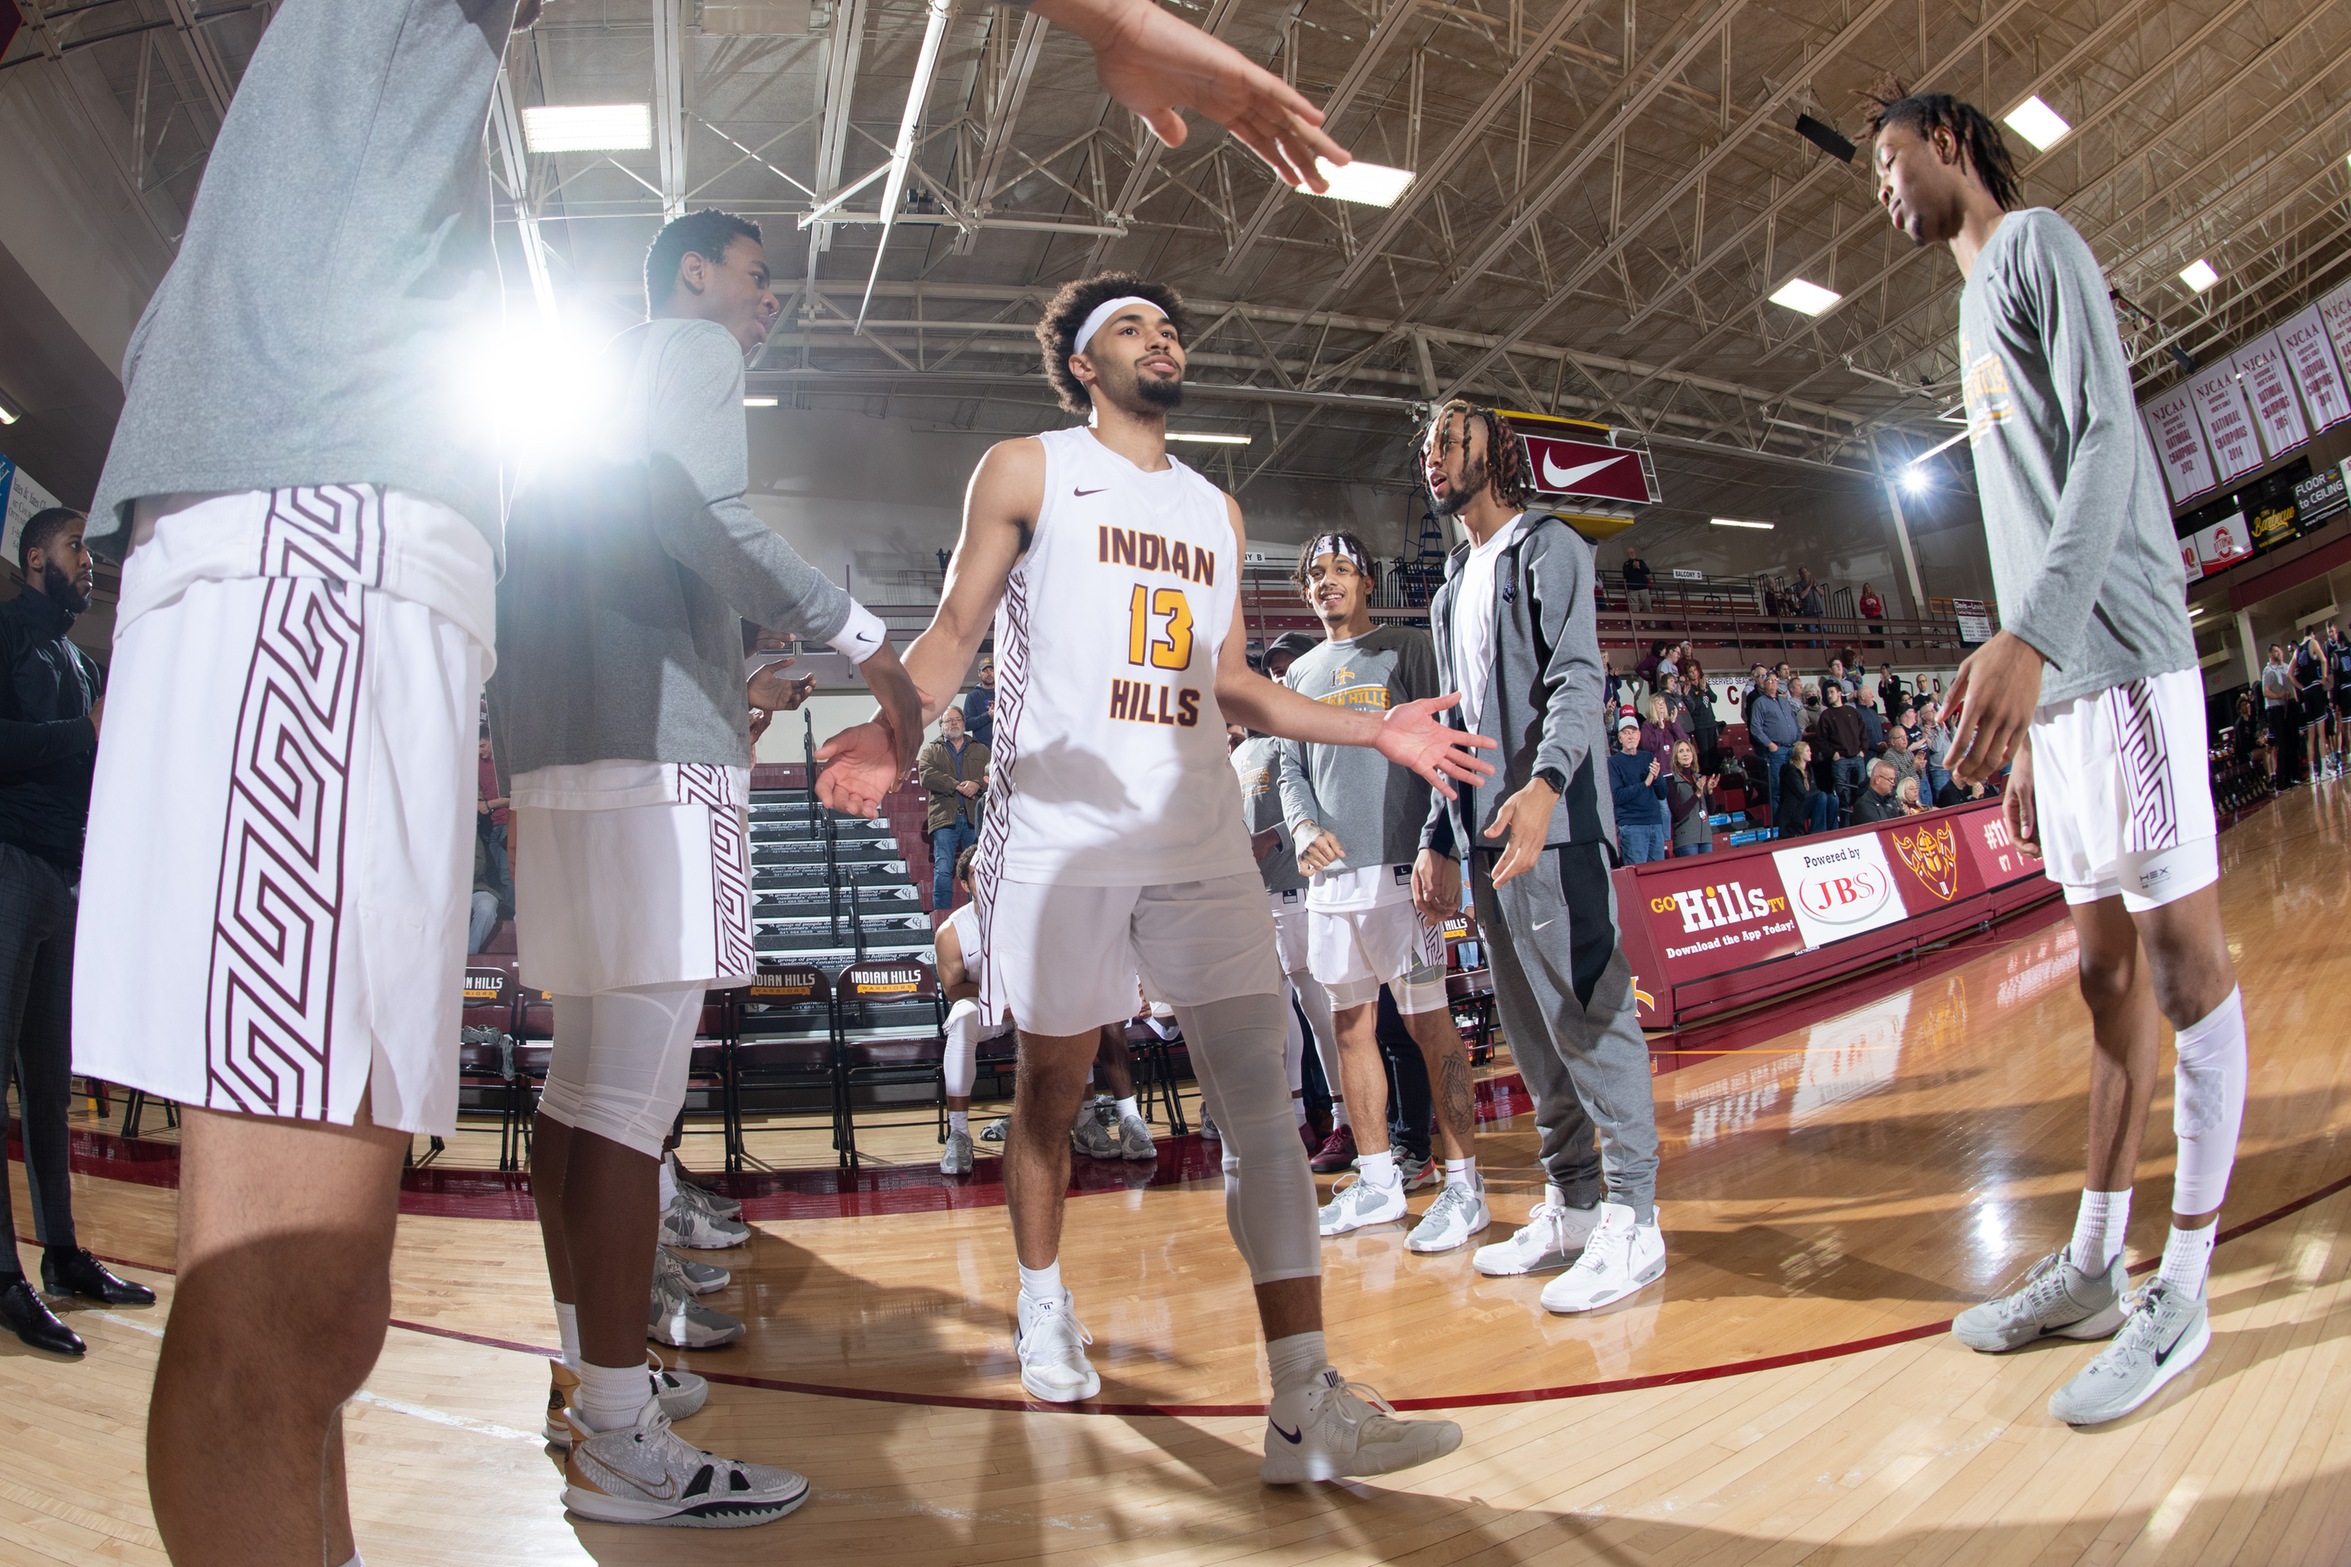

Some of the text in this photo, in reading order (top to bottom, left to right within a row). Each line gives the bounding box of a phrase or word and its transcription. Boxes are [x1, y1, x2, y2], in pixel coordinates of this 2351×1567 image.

[2286, 322, 2320, 351] NJCAA
[2242, 348, 2277, 375] NJCAA
[2301, 357, 2327, 379] NATIONAL
[2196, 373, 2233, 400] NJCAA
[2257, 380, 2284, 404] NATIONAL
[2305, 372, 2334, 396] CHAMPIONS
[2152, 397, 2187, 423] NJCAA
[2261, 395, 2290, 420] CHAMPIONS
[2210, 409, 2241, 434] NATIONAL
[2165, 428, 2192, 450] NATIONAL
[2214, 425, 2247, 450] CHAMPIONS
[2168, 441, 2198, 465] CHAMPIONS
[2228, 445, 2243, 461] 2014
[2295, 473, 2327, 497] FLOOR
[2299, 479, 2345, 509] to CEILING
[2251, 505, 2295, 538] Barbecue
[1098, 525, 1214, 588] INDIAN
[1675, 570, 1695, 578] BALCONY
[1128, 582, 1194, 671] 13
[1707, 677, 1736, 686] ESERVED
[1109, 677, 1200, 728] HILLS
[1349, 690, 1391, 710] HILLS
[1727, 685, 1740, 705] C
[1803, 847, 1861, 868] Powered by
[2139, 865, 2169, 882] HEX
[1817, 872, 1876, 911] JBS
[1444, 917, 1468, 931] HILLS
[1666, 919, 1796, 958] Download the App Today!
[474, 977, 503, 989] HILLS
[751, 973, 816, 987] NDIAN HILLS
[850, 969, 921, 984] INDIAN HILLS
